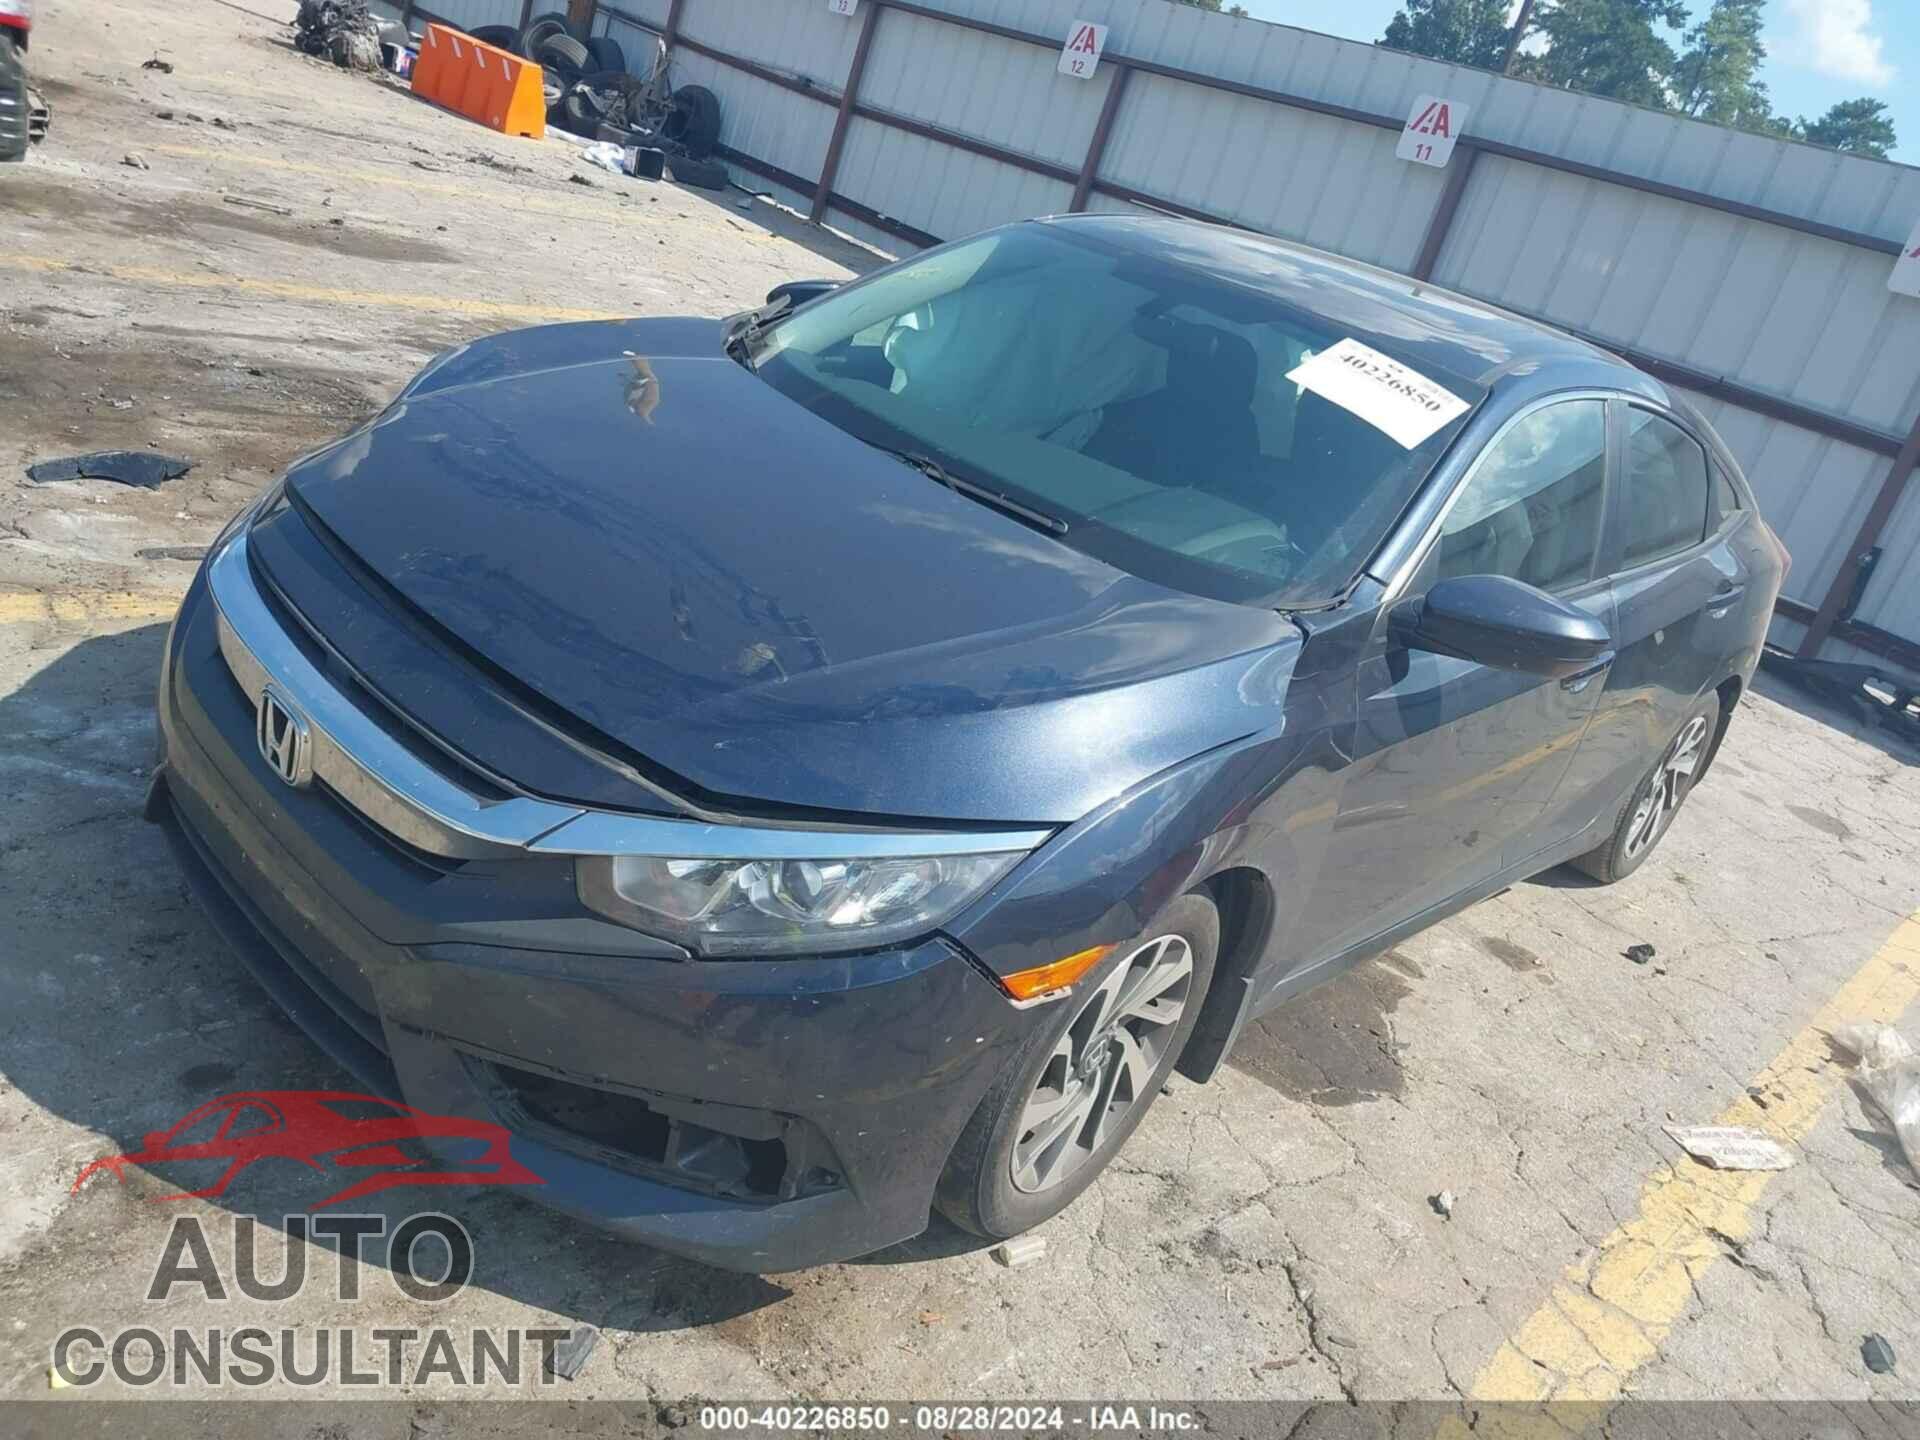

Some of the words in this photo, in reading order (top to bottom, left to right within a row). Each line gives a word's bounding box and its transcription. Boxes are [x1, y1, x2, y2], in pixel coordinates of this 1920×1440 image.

[1071, 59, 1085, 74] 12
[1415, 143, 1433, 160] 11
[1340, 355, 1441, 411] 40226850
